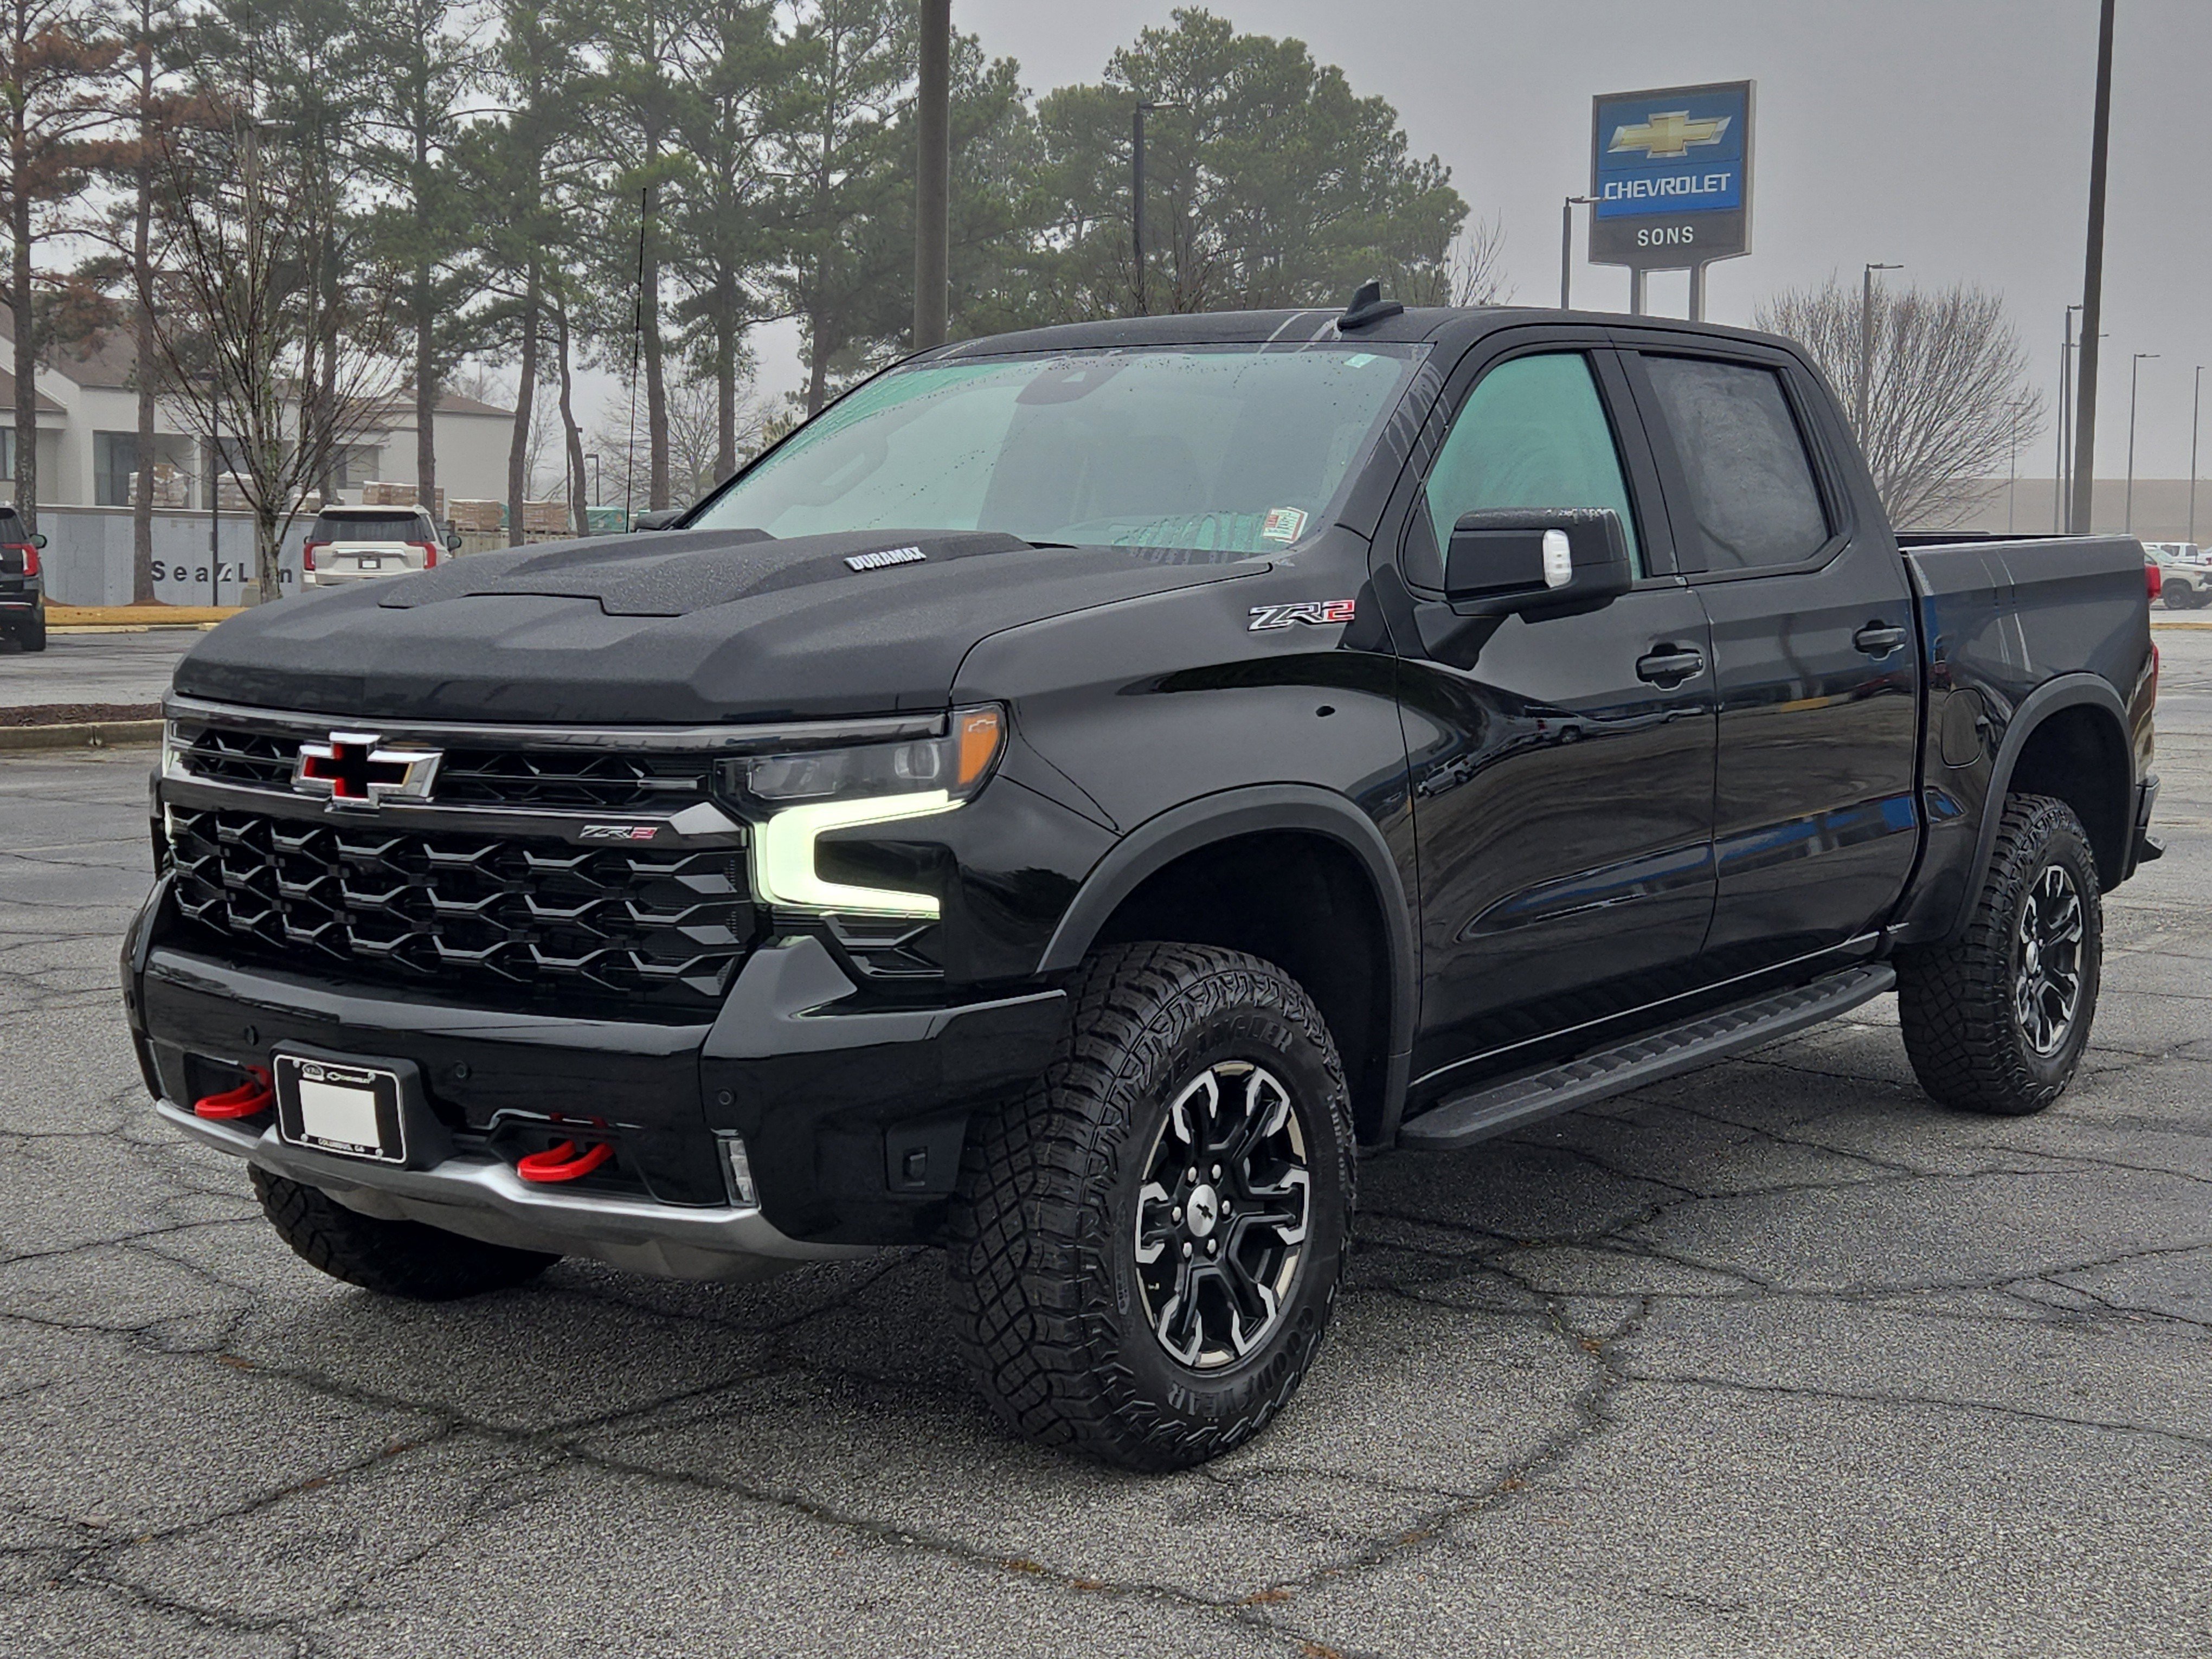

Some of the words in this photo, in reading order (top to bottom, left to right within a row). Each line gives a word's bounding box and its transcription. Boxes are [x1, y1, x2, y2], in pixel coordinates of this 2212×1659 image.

[1604, 173, 1731, 200] CHEVROLET
[1637, 226, 1694, 246] SONS
[844, 546, 927, 571] DURAMAX
[151, 561, 208, 582] Sea
[1249, 599, 1355, 631] ZR2
[578, 825, 658, 840] ZR2
